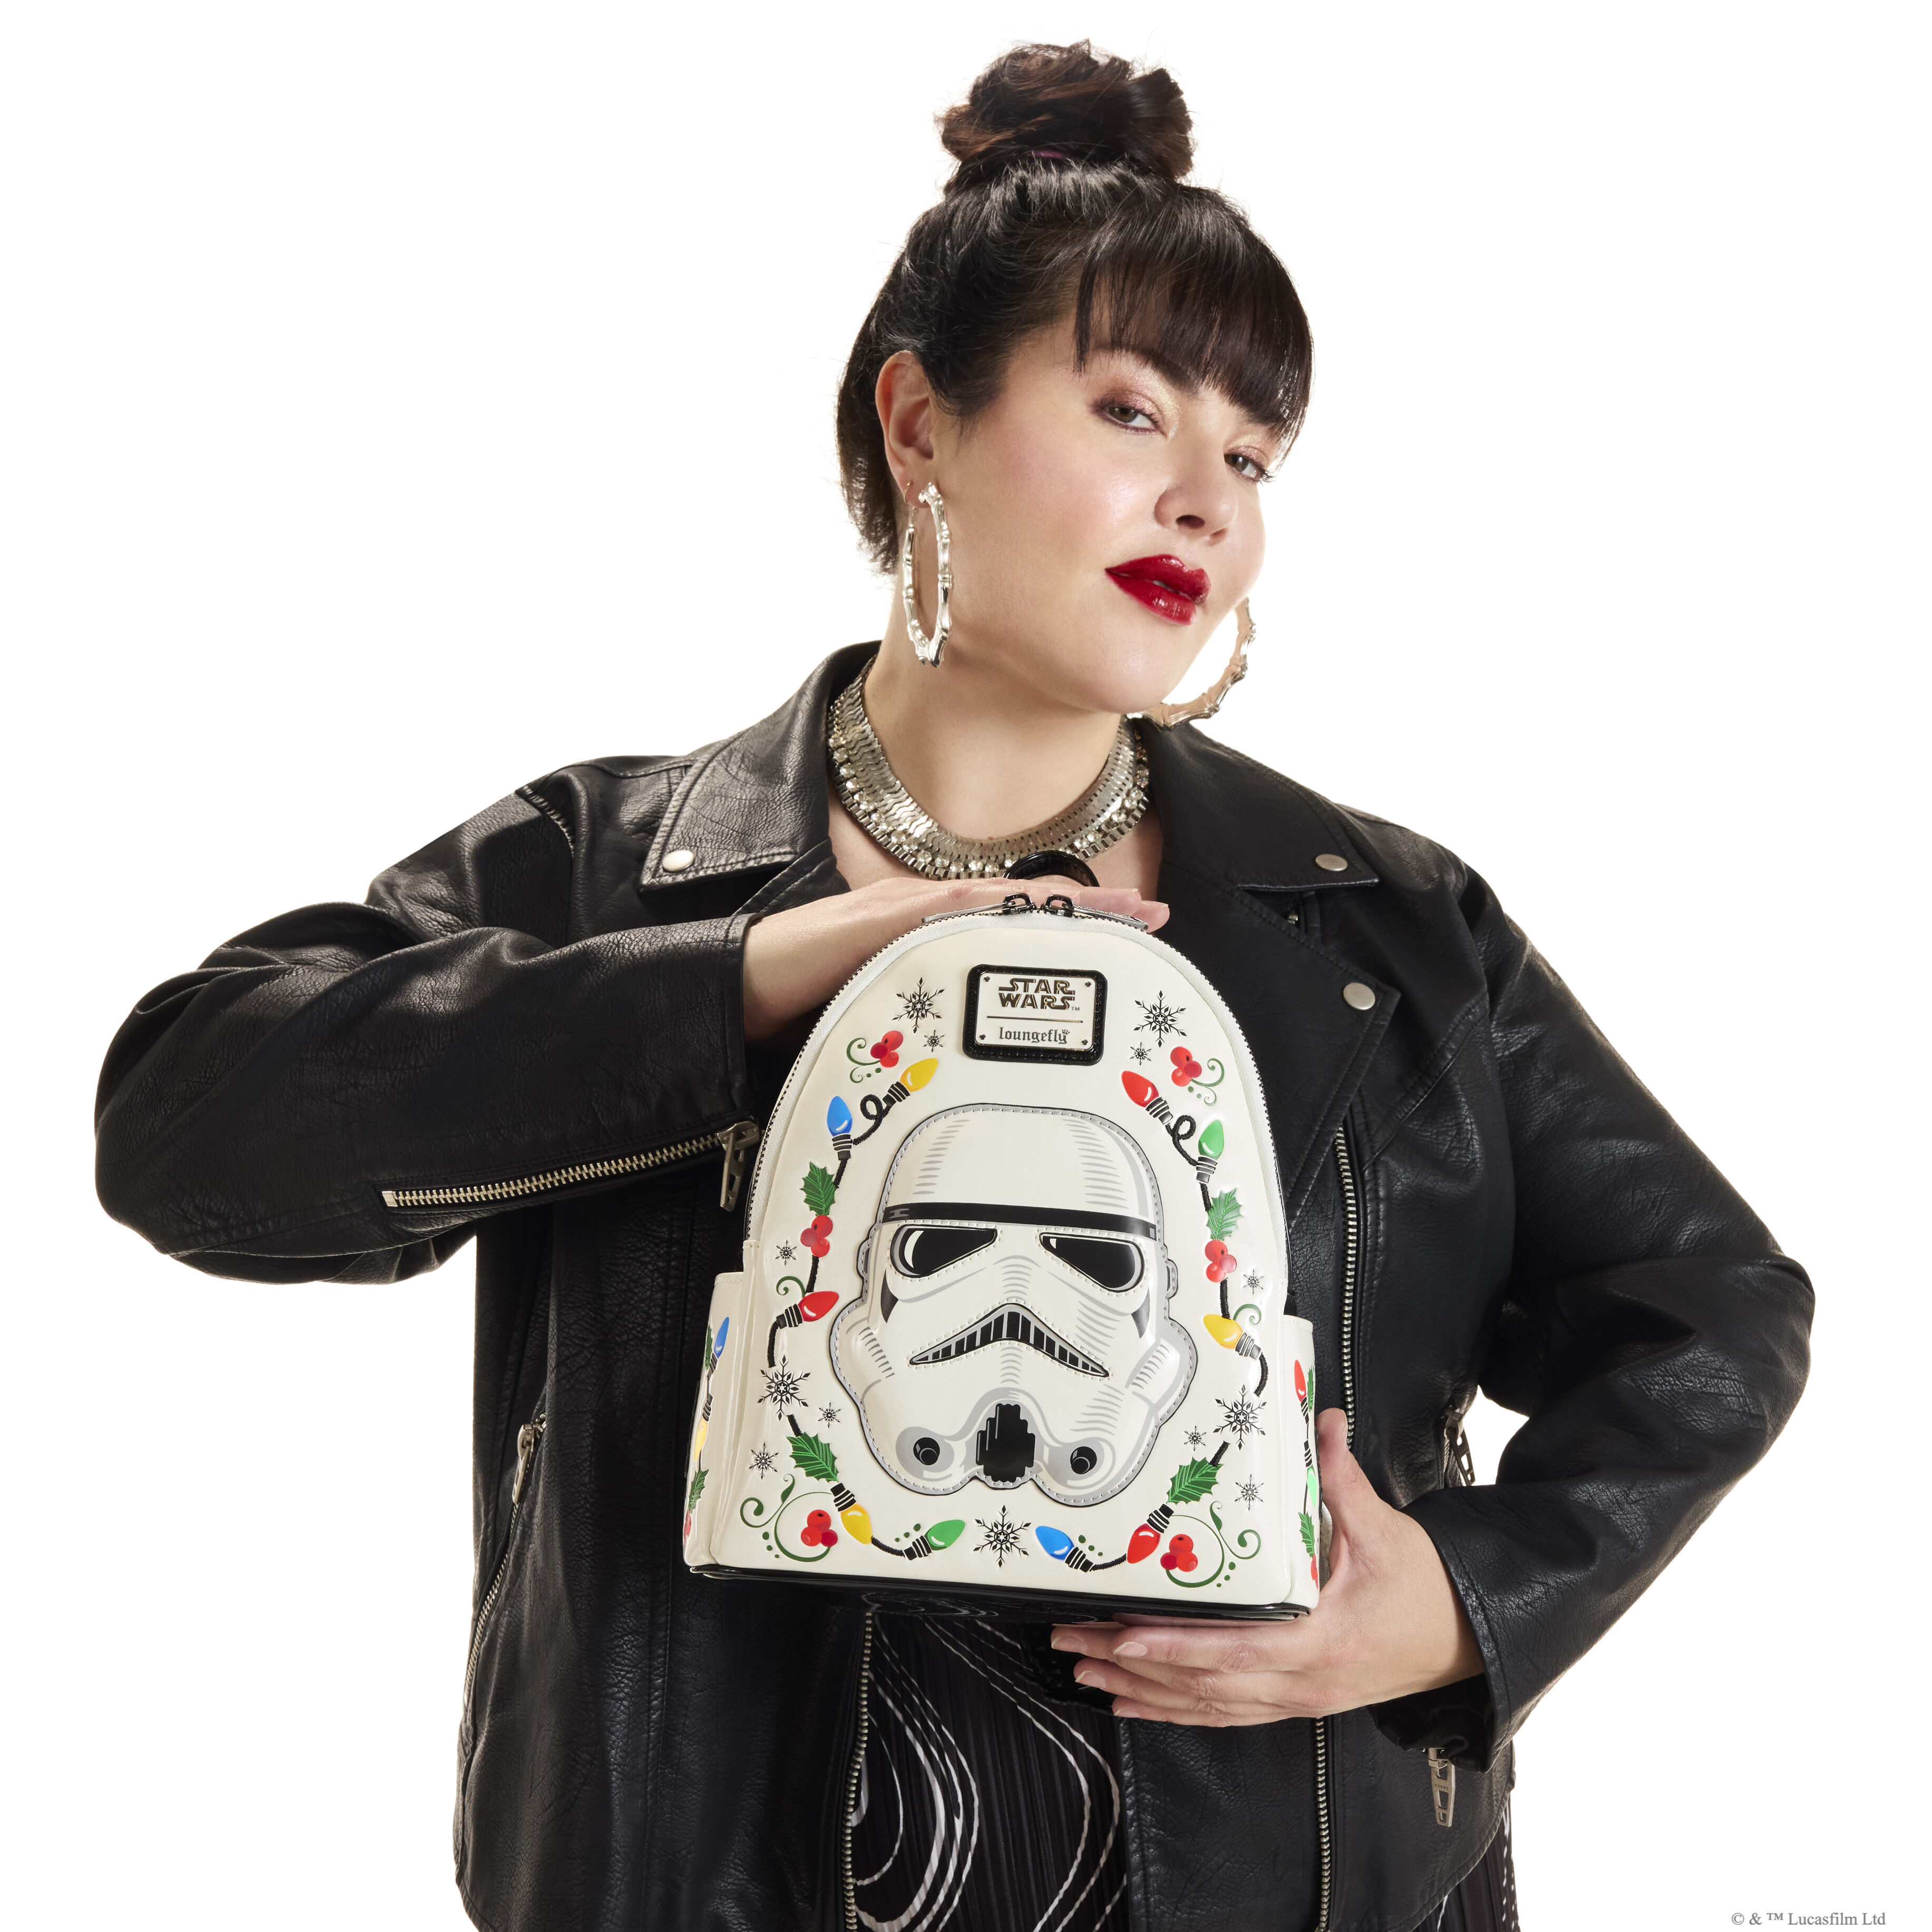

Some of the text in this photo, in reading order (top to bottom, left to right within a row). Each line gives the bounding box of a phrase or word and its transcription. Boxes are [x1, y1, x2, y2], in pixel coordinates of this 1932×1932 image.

[998, 977, 1076, 995] STAR
[998, 993, 1075, 1011] WARS
[999, 1026, 1070, 1045] loungefly
